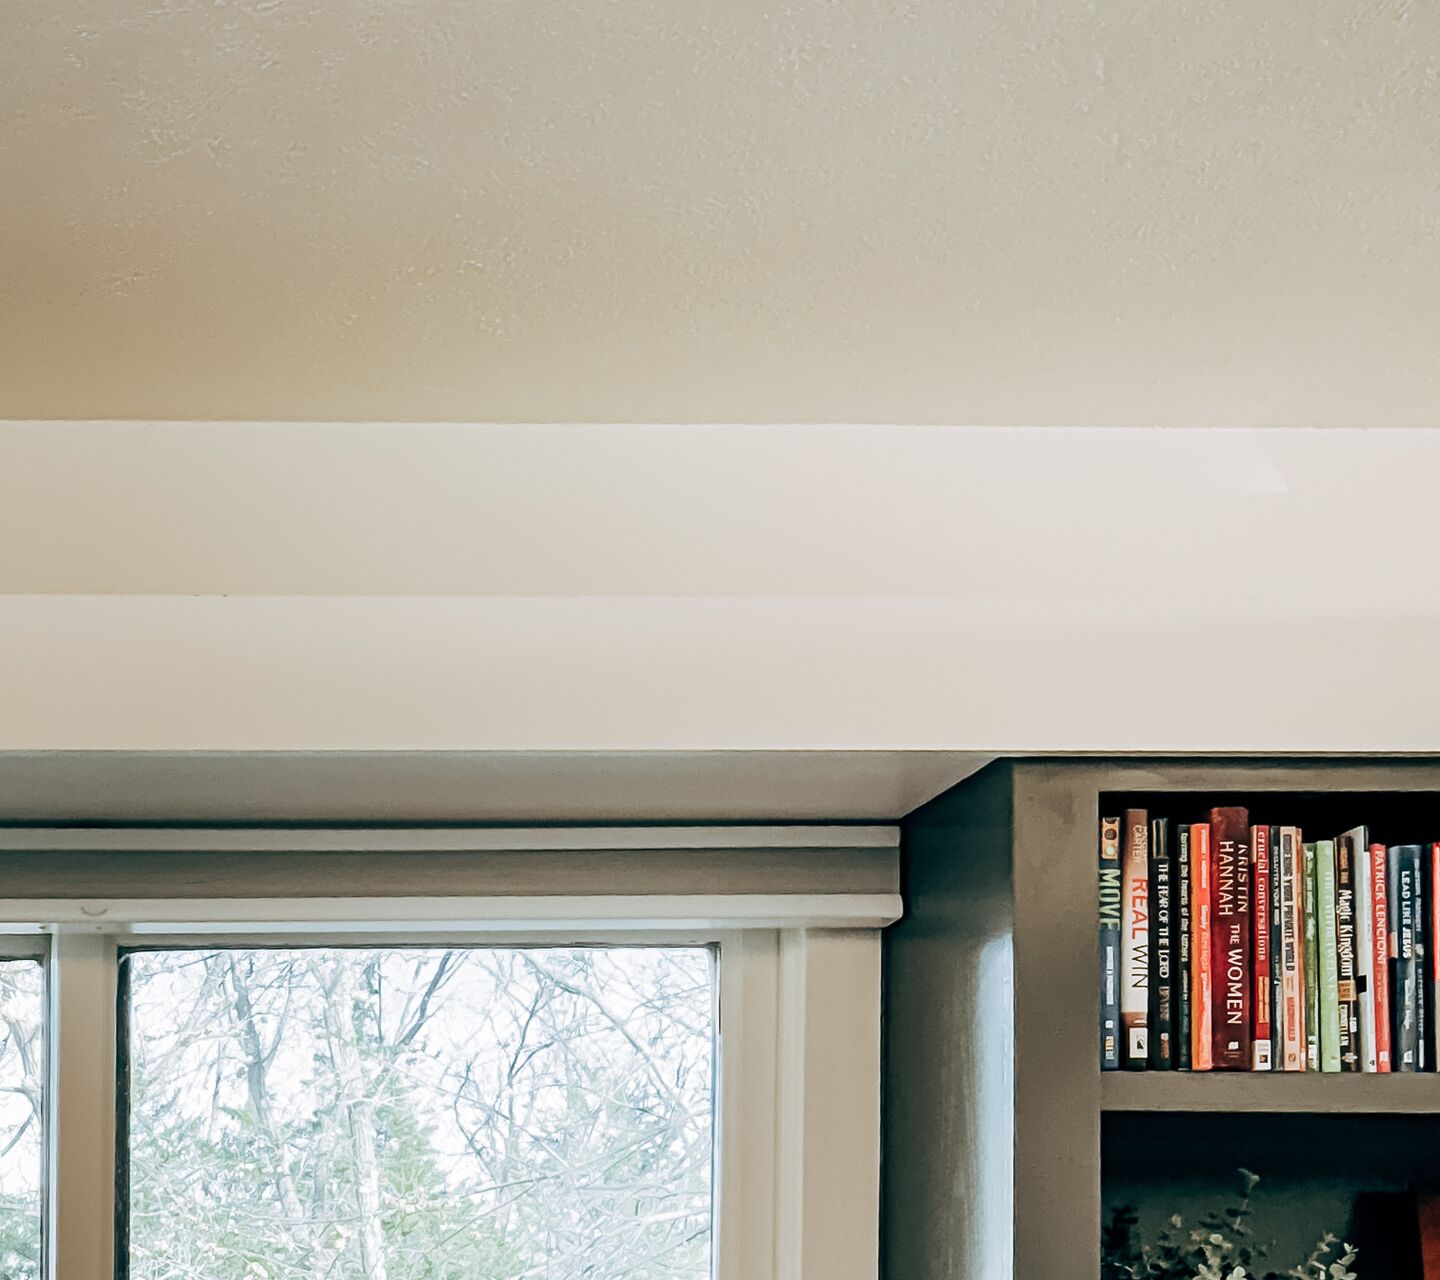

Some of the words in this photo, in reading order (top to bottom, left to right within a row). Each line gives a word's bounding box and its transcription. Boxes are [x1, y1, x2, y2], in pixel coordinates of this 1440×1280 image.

[1158, 863, 1170, 882] THE
[1257, 831, 1269, 874] crucial
[1218, 840, 1235, 916] HANNAH
[1237, 843, 1249, 913] KRISTIN
[1374, 850, 1387, 901] PATRICK
[1401, 871, 1411, 899] LEAD
[1131, 879, 1149, 939] REAL
[1157, 885, 1170, 908] FEAR
[1336, 889, 1353, 922] Magic
[1402, 901, 1412, 926] LIKE
[1158, 910, 1170, 924] OF
[1229, 923, 1241, 946] THE
[1257, 878, 1269, 962] conversations
[1283, 904, 1295, 941] PRIVATE
[1375, 904, 1388, 965] LENCIONI
[1337, 924, 1354, 978] Kingdom
[1402, 927, 1412, 960] JESUS
[1131, 944, 1149, 989] WIN
[1158, 949, 1170, 979] LORD
[1226, 948, 1244, 1025] WOMEN
